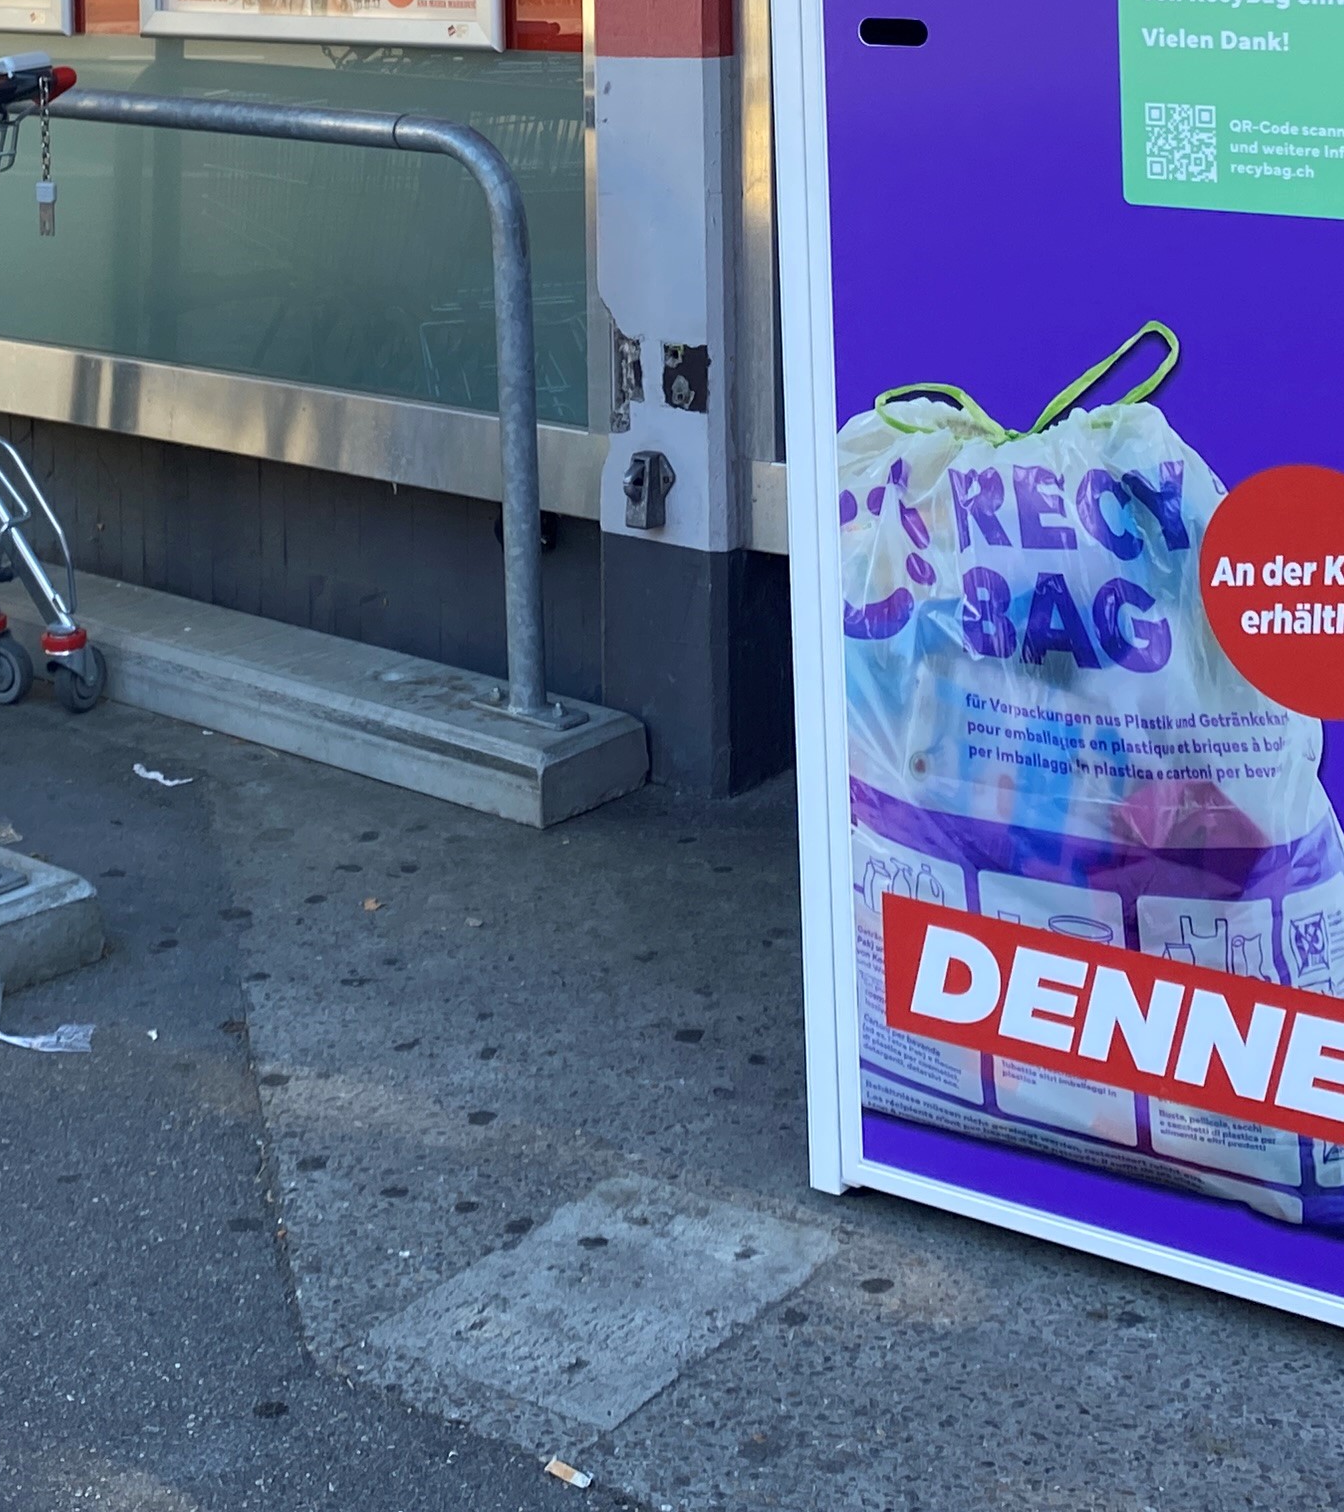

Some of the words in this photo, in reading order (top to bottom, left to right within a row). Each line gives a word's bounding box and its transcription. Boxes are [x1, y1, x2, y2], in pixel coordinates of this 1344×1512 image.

[1142, 28, 1214, 49] Vielen
[1221, 31, 1289, 51] Dank!
[1230, 120, 1299, 136] QR-Code
[1230, 141, 1258, 154] und
[1262, 143, 1320, 158] weitere
[1231, 162, 1314, 180] recybag.ch
[948, 460, 1190, 561] RECY
[1211, 557, 1256, 587] An
[1263, 555, 1317, 587] der
[962, 566, 1172, 673] BAG
[966, 693, 987, 709] für
[989, 698, 1091, 726] Verpackungen
[1096, 714, 1121, 726] aus
[1125, 714, 1173, 729] Plastik
[1176, 713, 1196, 728] und
[968, 721, 1000, 735] pour
[1090, 739, 1106, 750] en
[1111, 736, 1175, 759] plastique
[1178, 740, 1190, 753] et
[1193, 739, 1248, 757] briques
[1253, 737, 1261, 752] à
[969, 745, 992, 759] per
[1094, 760, 1154, 780] plastica
[1157, 771, 1163, 779] e
[1166, 764, 1212, 779] cartoni
[1216, 768, 1240, 782] per
